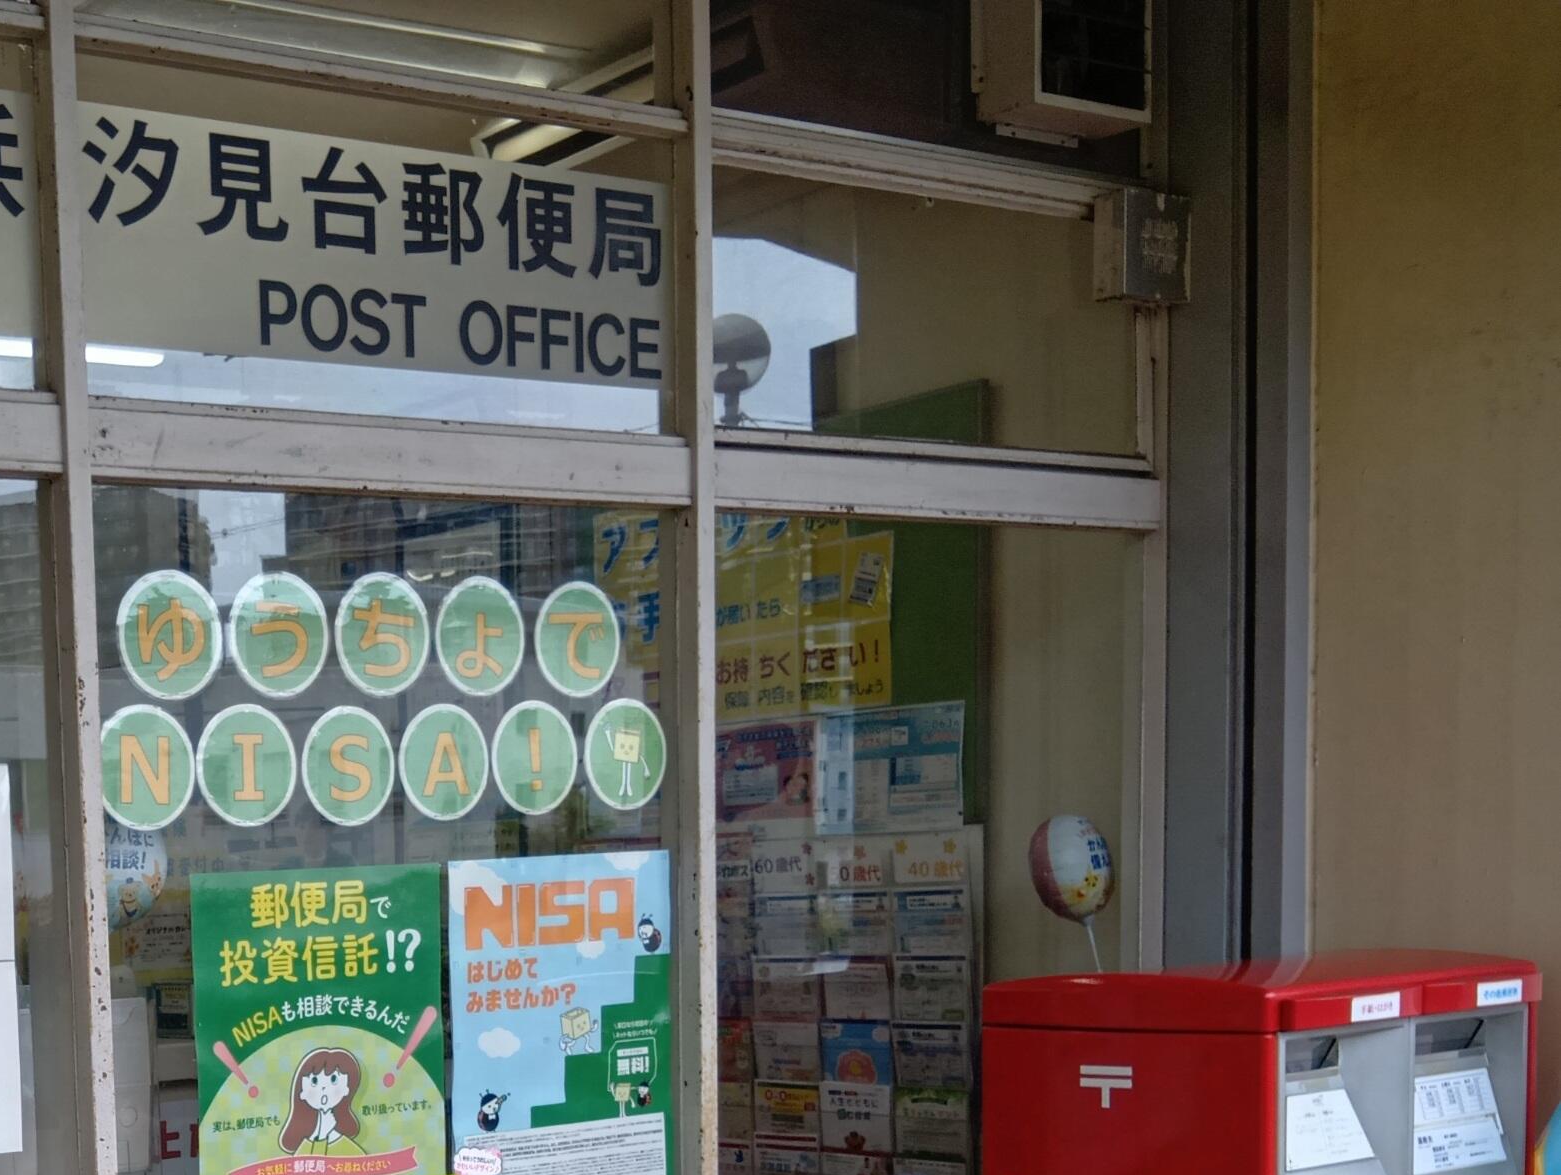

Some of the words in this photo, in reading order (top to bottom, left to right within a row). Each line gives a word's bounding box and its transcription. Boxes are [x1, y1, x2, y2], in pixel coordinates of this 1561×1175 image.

[259, 281, 428, 359] POST
[460, 299, 663, 381] OFFICE
[139, 597, 605, 682] ゆうちょで
[119, 728, 545, 805] NISA!
[250, 880, 392, 930] 郵便局で
[464, 877, 636, 951] NISA
[467, 957, 539, 983] はじめて
[231, 993, 411, 1048] NISAも相談できるんだ
[466, 982, 577, 1014] みませんか?
[212, 1115, 281, 1134] 実は、郵便局でも
[361, 1100, 432, 1116] 取り扱っています。
